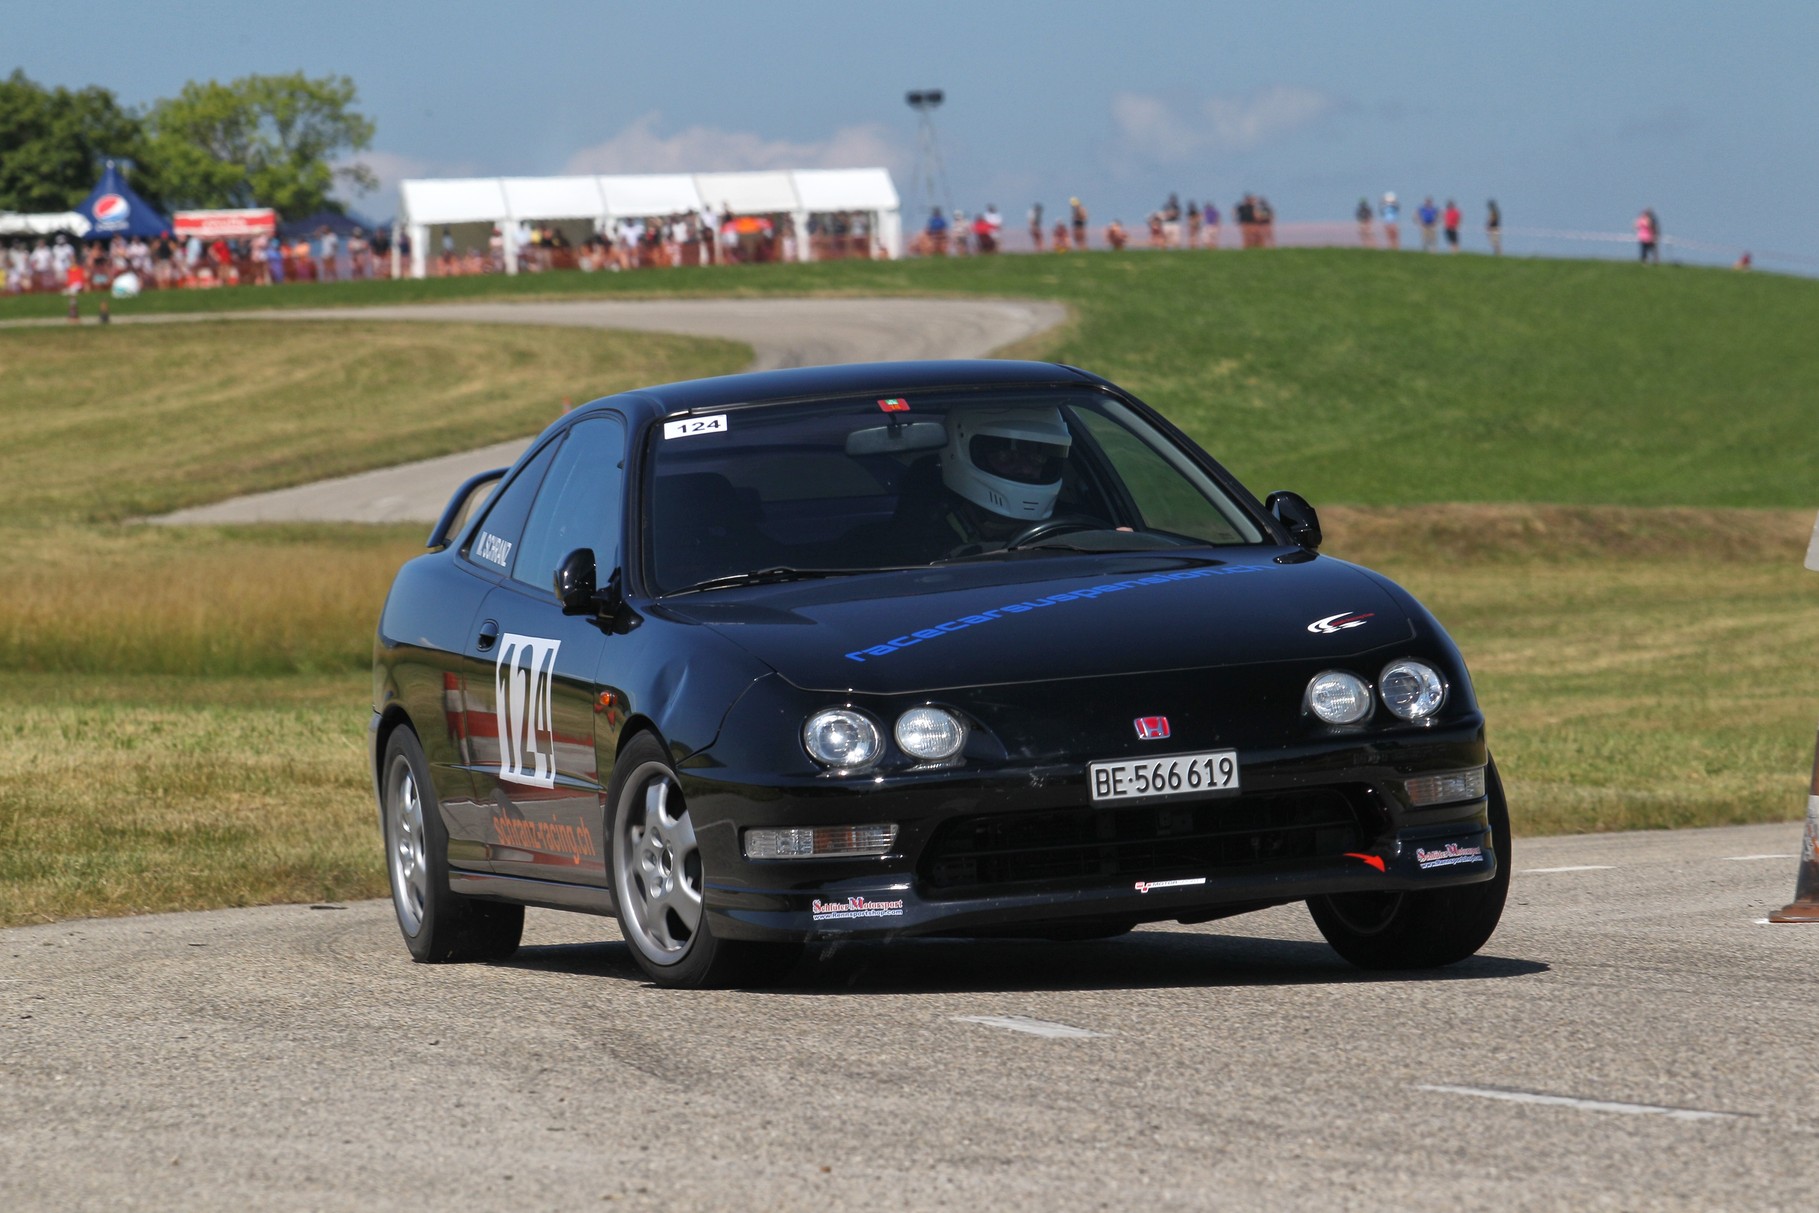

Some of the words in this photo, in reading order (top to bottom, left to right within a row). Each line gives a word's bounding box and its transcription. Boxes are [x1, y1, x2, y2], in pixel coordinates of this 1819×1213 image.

[676, 418, 721, 434] 124
[845, 563, 1276, 662] racecarsuspension.ch
[498, 643, 555, 780] 124
[848, 896, 903, 912] Motorsport
